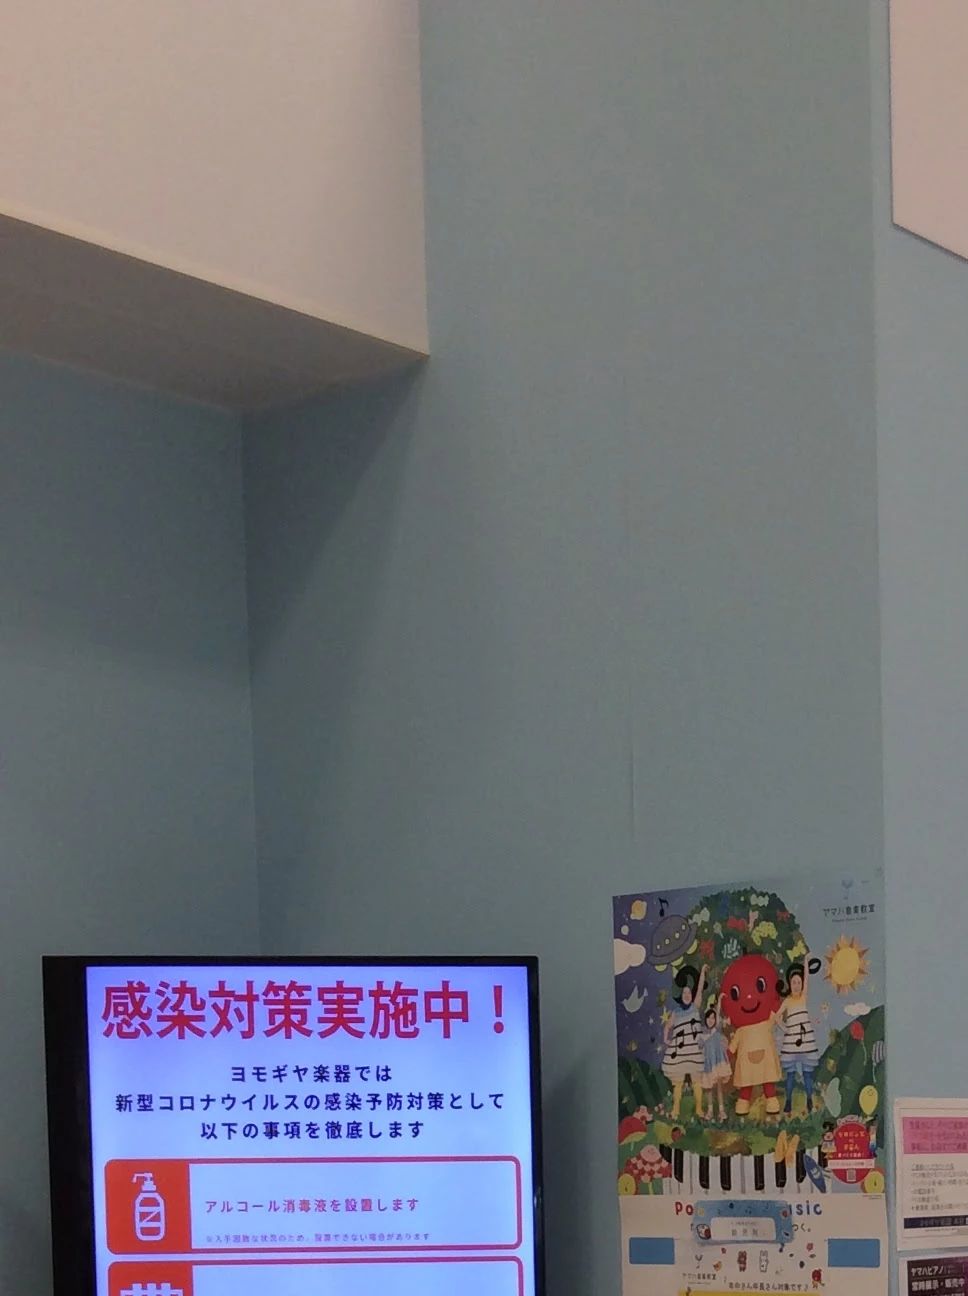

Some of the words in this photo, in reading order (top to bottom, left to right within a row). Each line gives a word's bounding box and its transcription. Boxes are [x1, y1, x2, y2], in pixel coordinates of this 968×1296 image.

[102, 979, 505, 1041] 感染対策実施中！
[230, 1063, 393, 1084] ヨモギヤ楽器では
[115, 1091, 504, 1114] 新型コロナウイルスの感染予防対策として
[200, 1121, 425, 1141] 以下の事項を徹底します
[205, 1197, 419, 1214] アルコール消毒液を設置します
